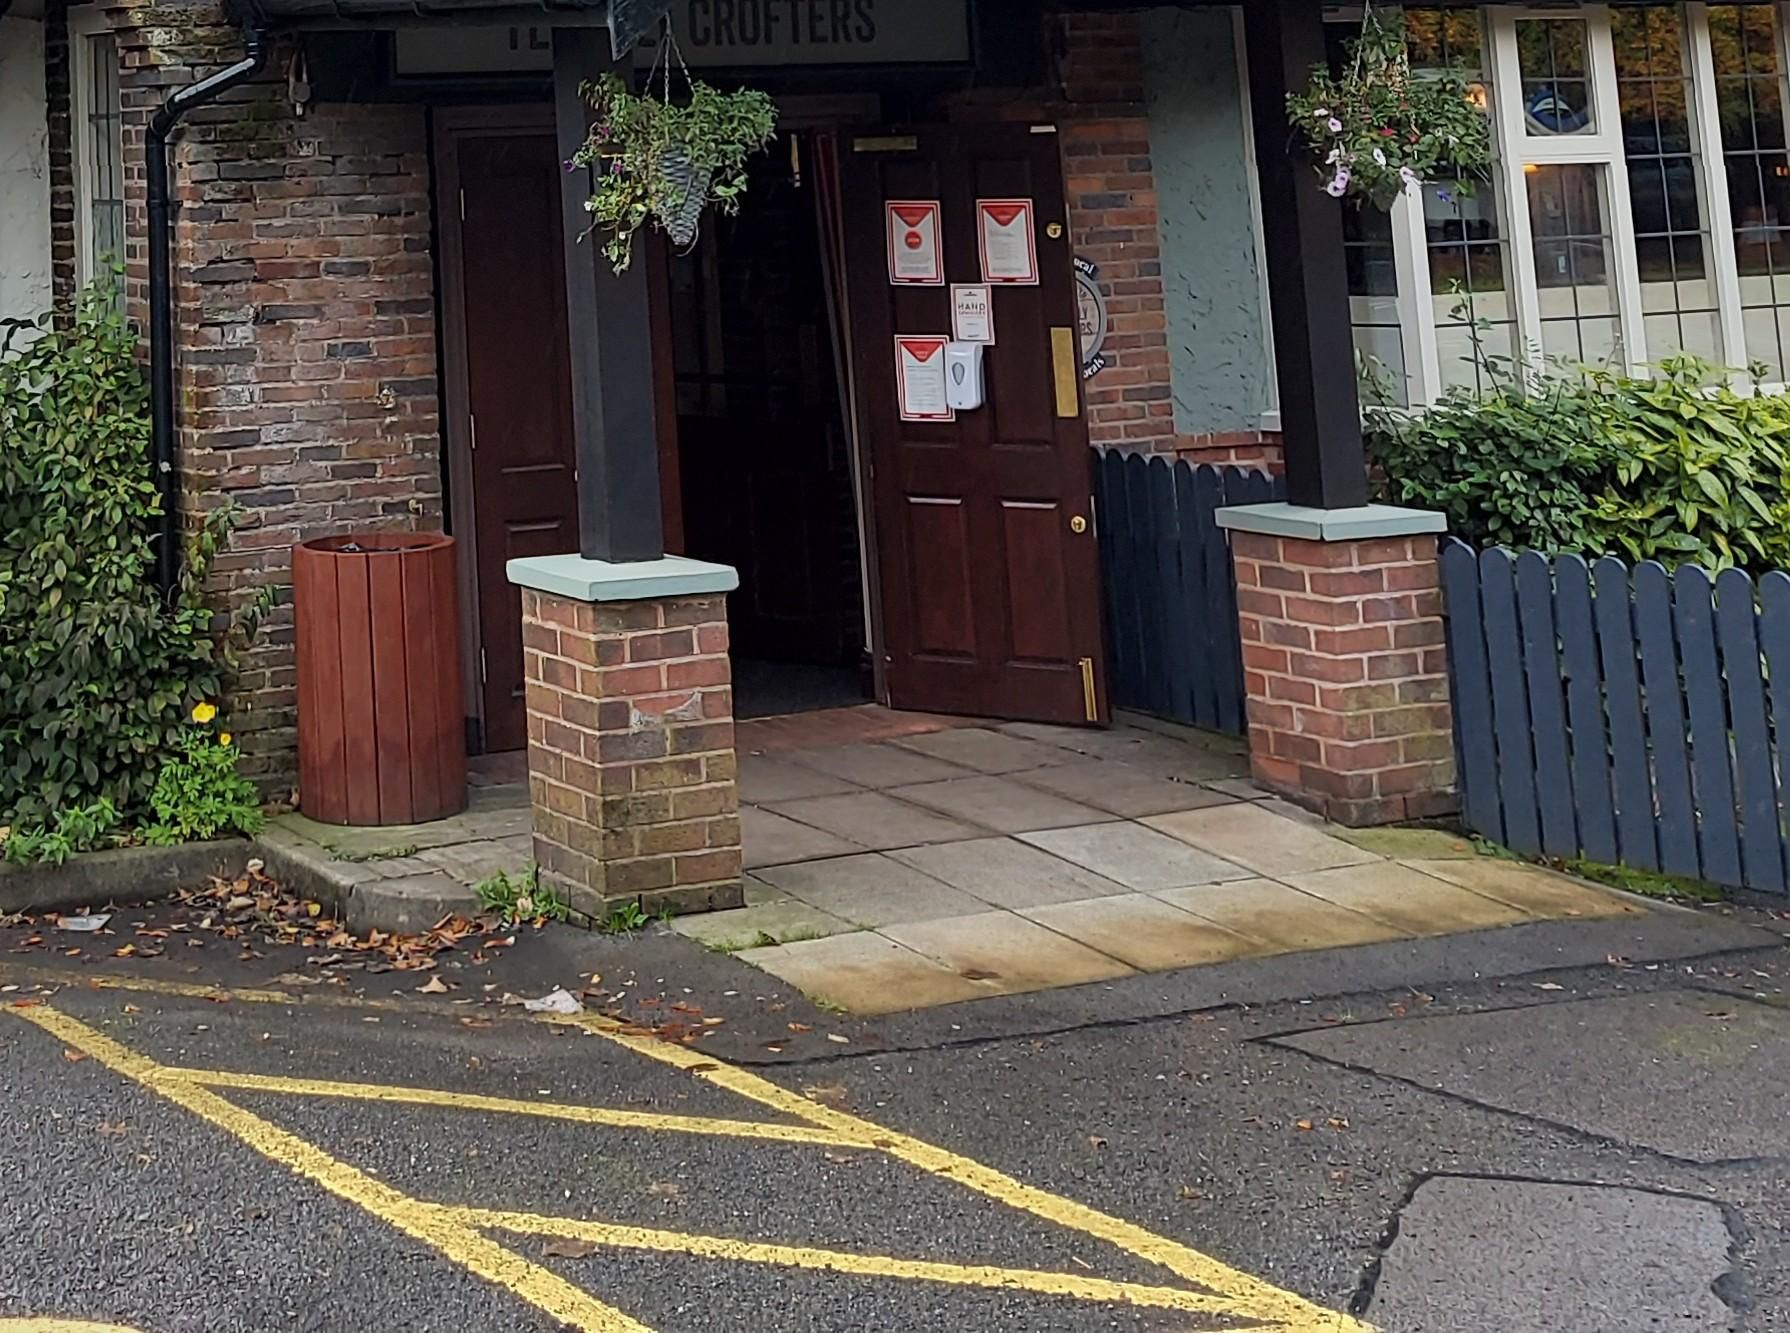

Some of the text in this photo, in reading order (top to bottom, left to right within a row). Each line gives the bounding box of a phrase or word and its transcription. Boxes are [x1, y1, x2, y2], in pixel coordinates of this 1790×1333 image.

[688, 0, 879, 47] CROFTERS
[1073, 257, 1095, 274] ocal
[958, 302, 986, 310] HAND
[1083, 358, 1105, 379] ocals
